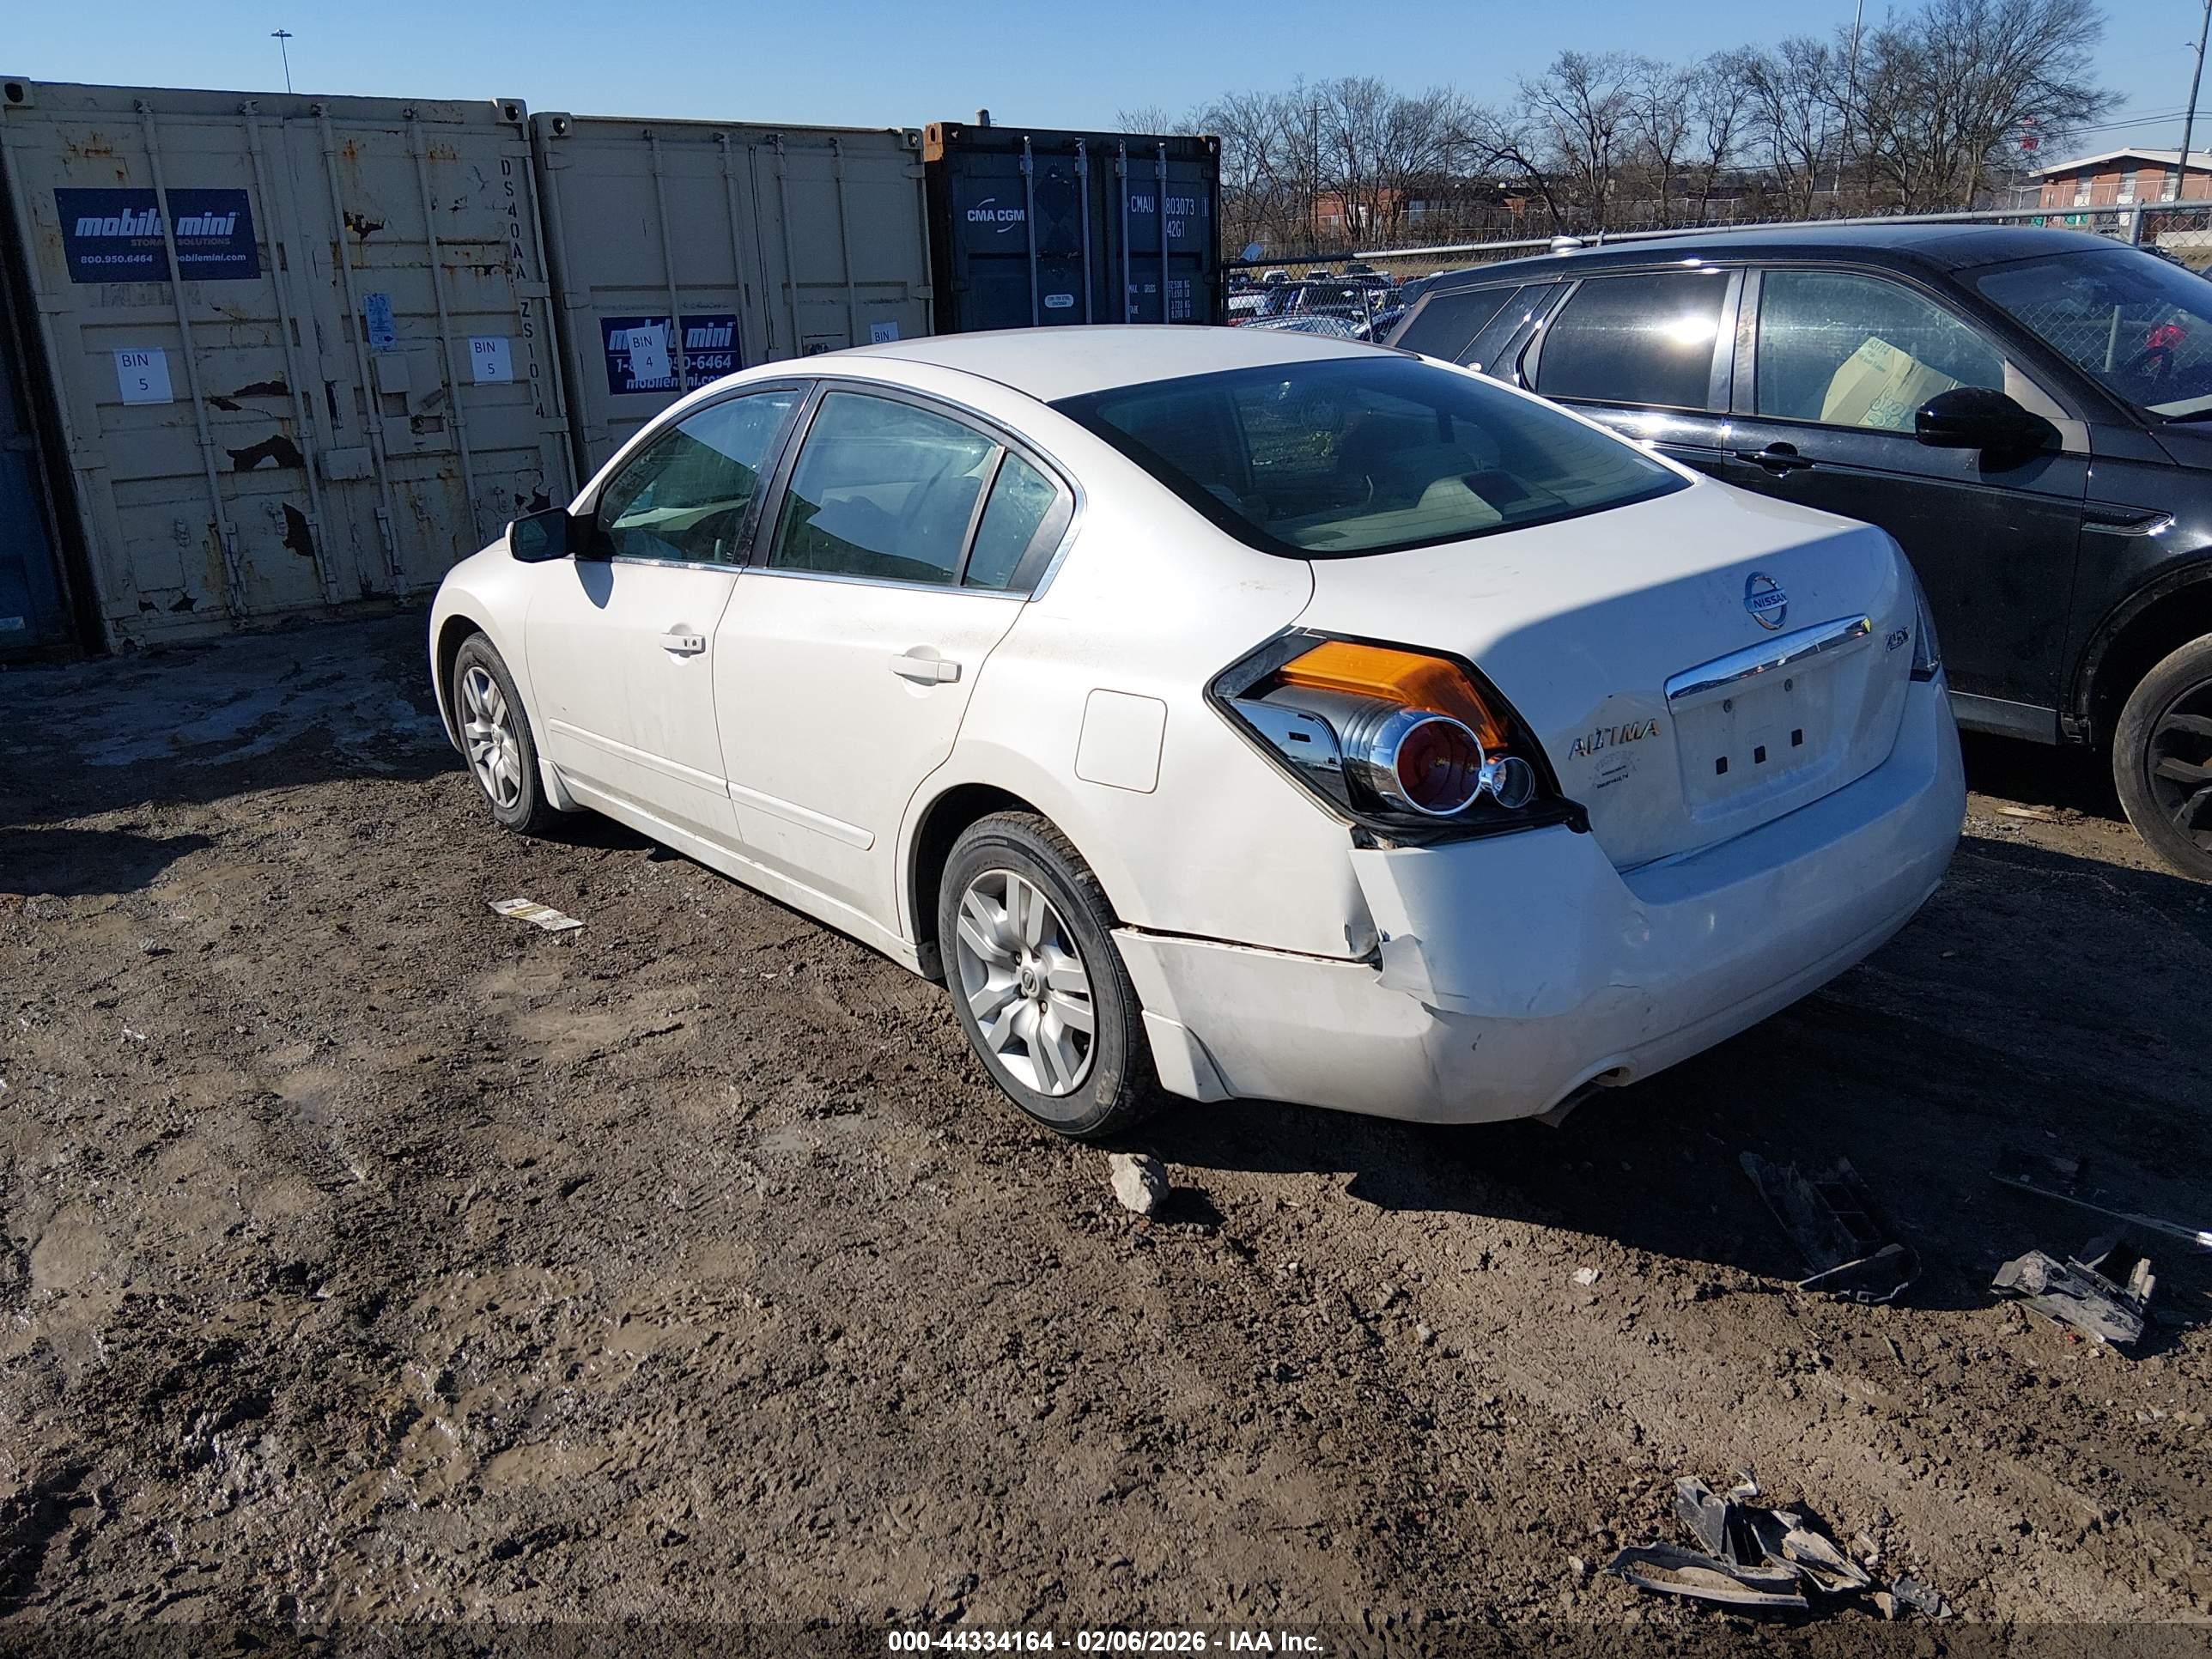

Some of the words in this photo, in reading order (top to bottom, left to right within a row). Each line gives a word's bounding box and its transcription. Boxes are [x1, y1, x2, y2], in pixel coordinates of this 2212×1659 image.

[1131, 195, 1155, 214] CMAU
[1165, 197, 1194, 216] 803073
[967, 210, 996, 222] CMA
[997, 210, 1025, 222] CGM
[176, 212, 237, 235] mini
[1167, 220, 1185, 238] 42G1
[80, 254, 153, 264] 800.950.6464
[176, 253, 246, 262] obilemini.com
[686, 322, 733, 349] mini
[874, 330, 890, 342] BIN
[474, 342, 496, 354] BIN
[633, 336, 653, 349] BIN
[121, 353, 149, 368] BIN
[646, 356, 653, 368] 4
[488, 363, 495, 374] 5
[138, 378, 149, 391] 5
[1753, 592, 1787, 609] NISSAN
[1568, 718, 1660, 761] ALTIMA
